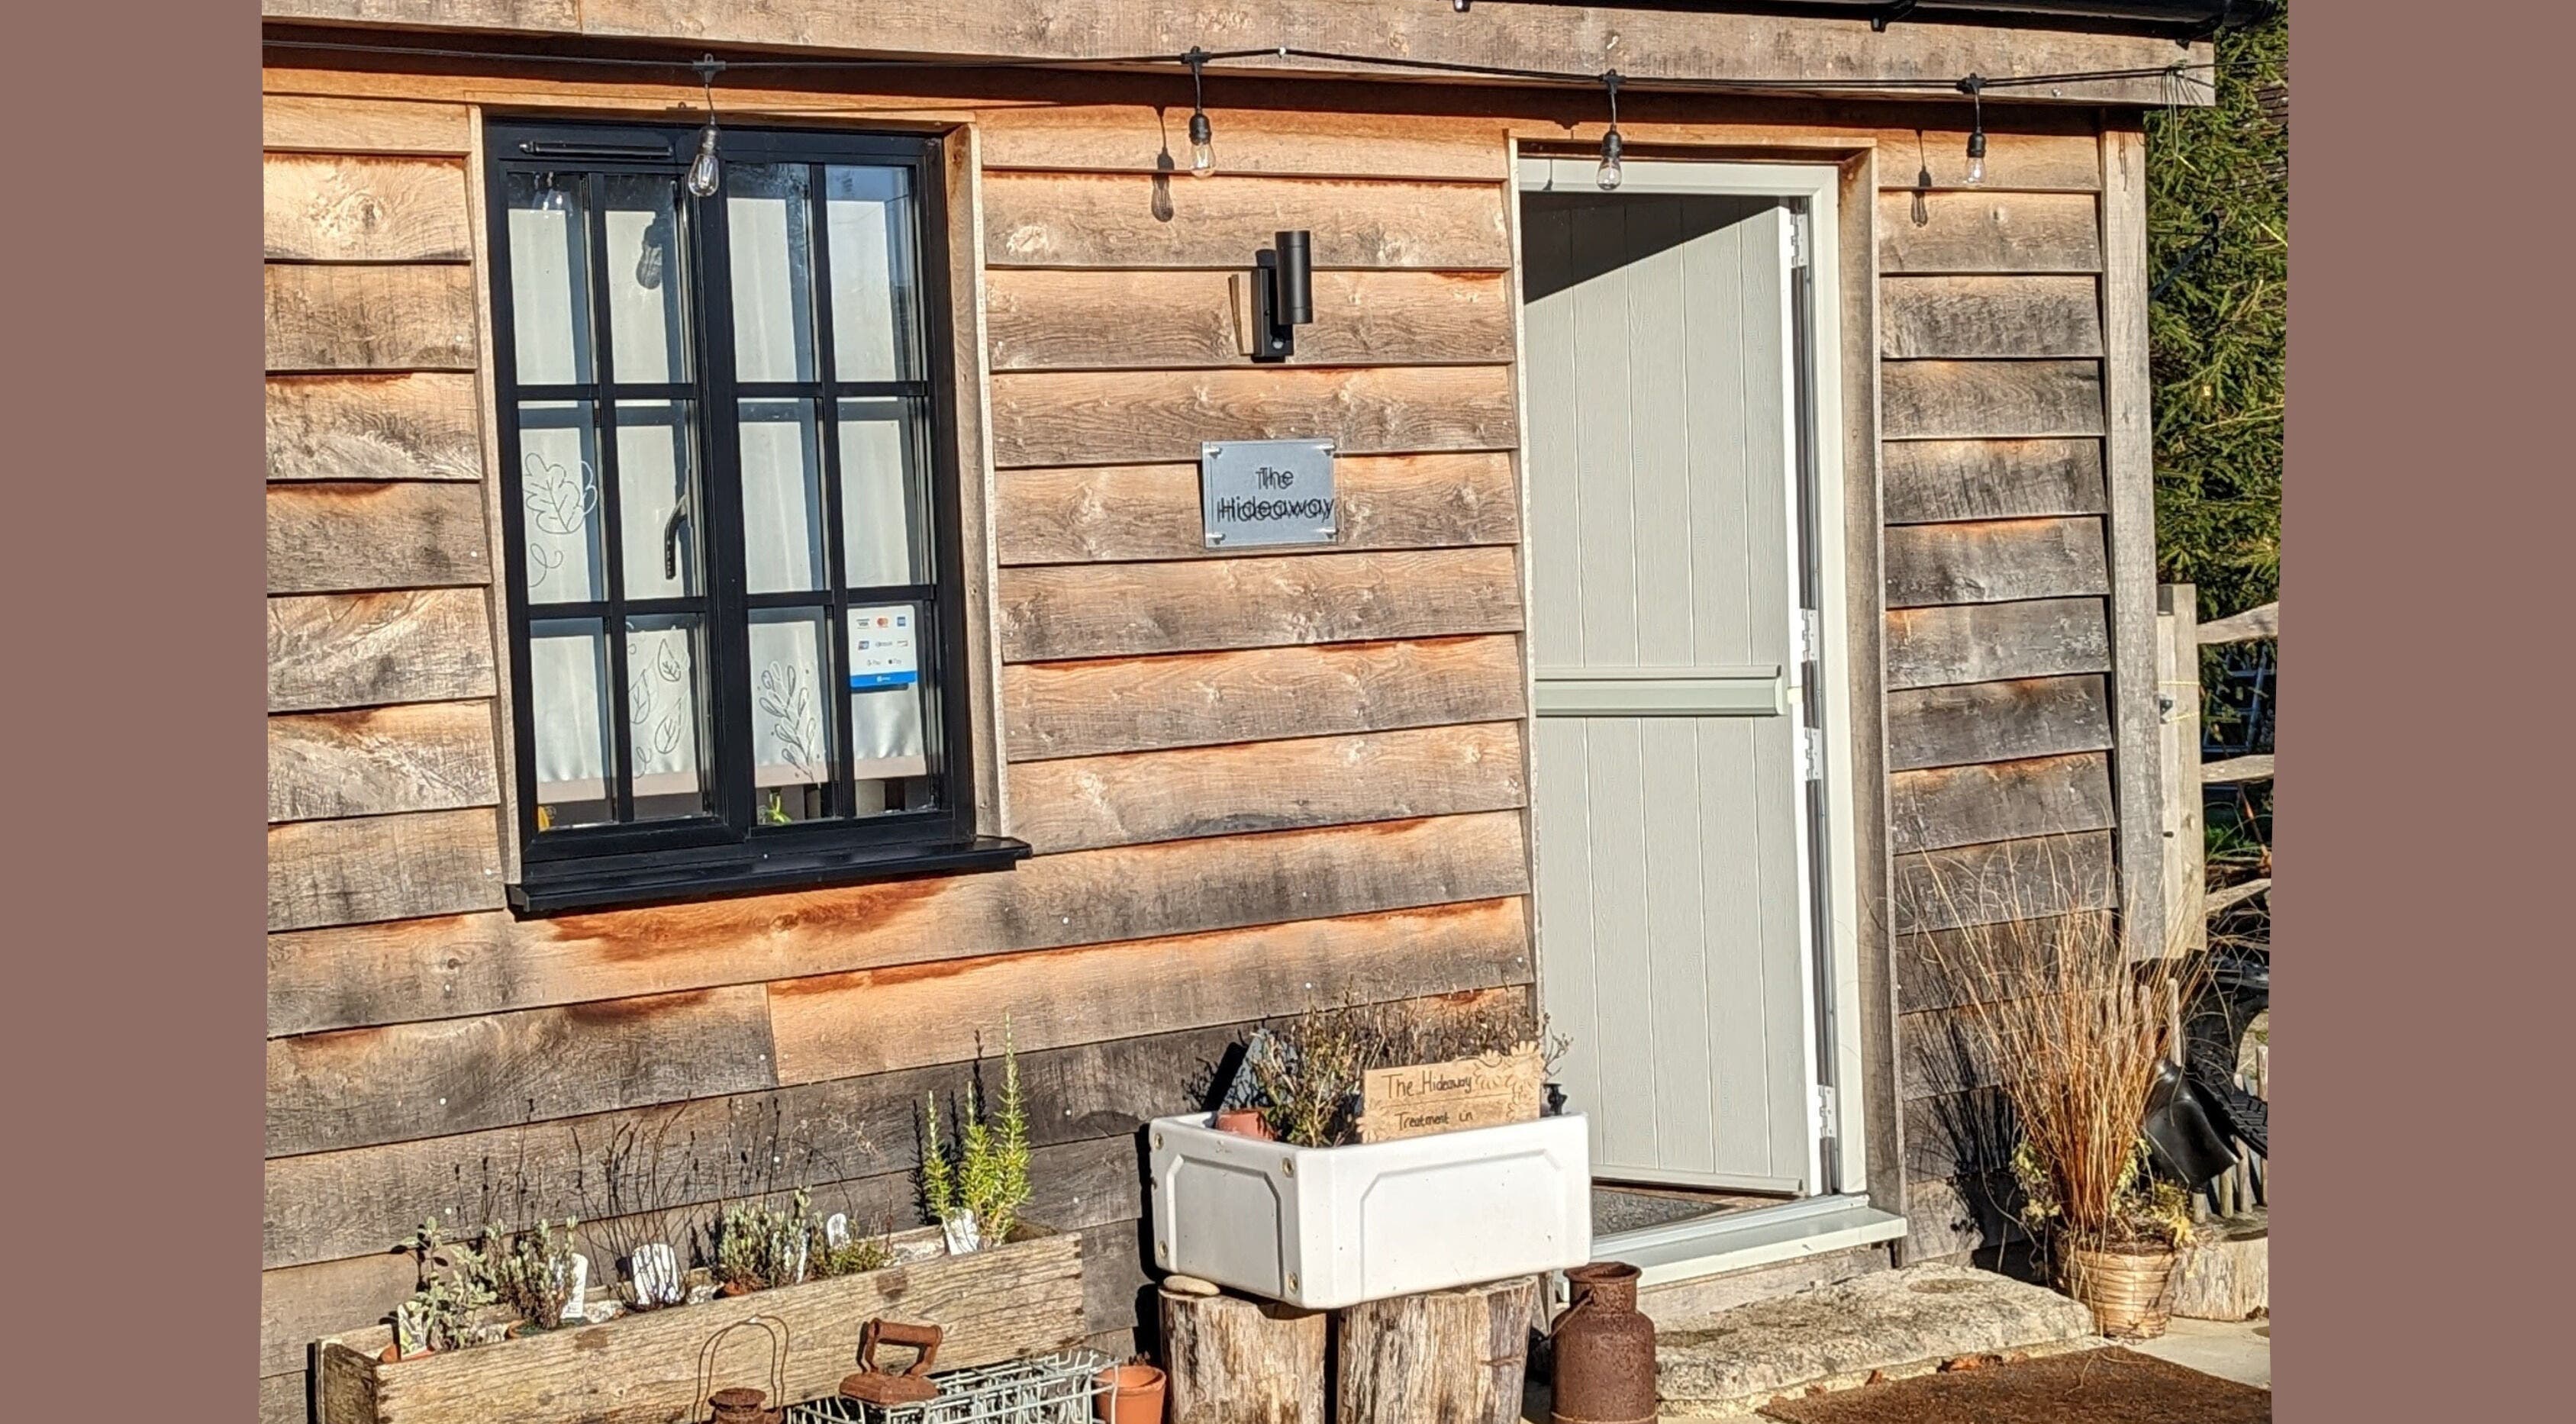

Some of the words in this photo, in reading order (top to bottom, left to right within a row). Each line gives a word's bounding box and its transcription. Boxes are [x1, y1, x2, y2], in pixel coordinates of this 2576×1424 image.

[1256, 466, 1294, 488] The
[1218, 495, 1334, 521] Hideaway
[1381, 1073, 1414, 1099] The
[1422, 1070, 1472, 1094] Hideaway
[1459, 1111, 1473, 1122] in
